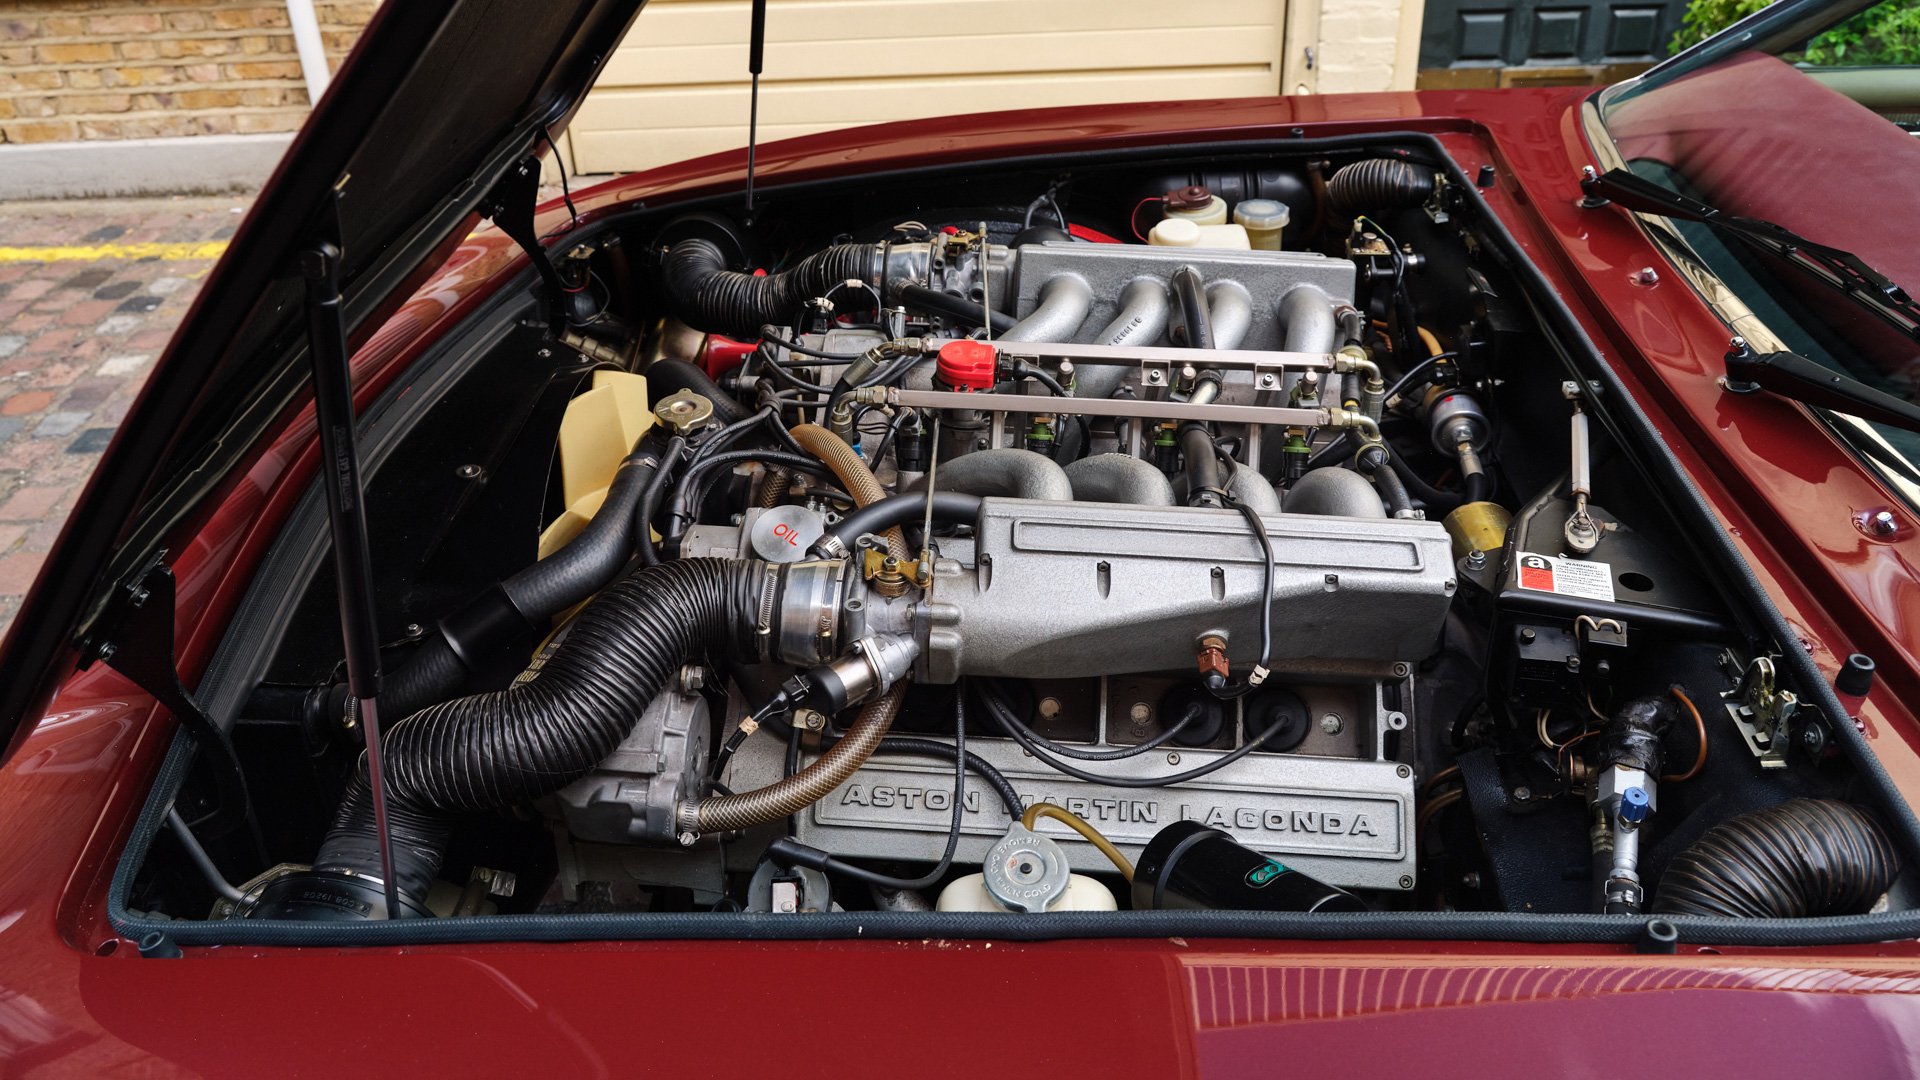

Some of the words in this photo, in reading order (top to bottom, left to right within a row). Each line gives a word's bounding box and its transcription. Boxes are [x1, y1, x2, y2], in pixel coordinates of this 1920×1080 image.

[773, 523, 798, 547] OIL
[1528, 557, 1545, 569] a
[1565, 561, 1598, 570] WARNING
[841, 784, 980, 813] ASTON
[1181, 804, 1378, 836] LAGONDA
[1023, 883, 1051, 898] COLD
